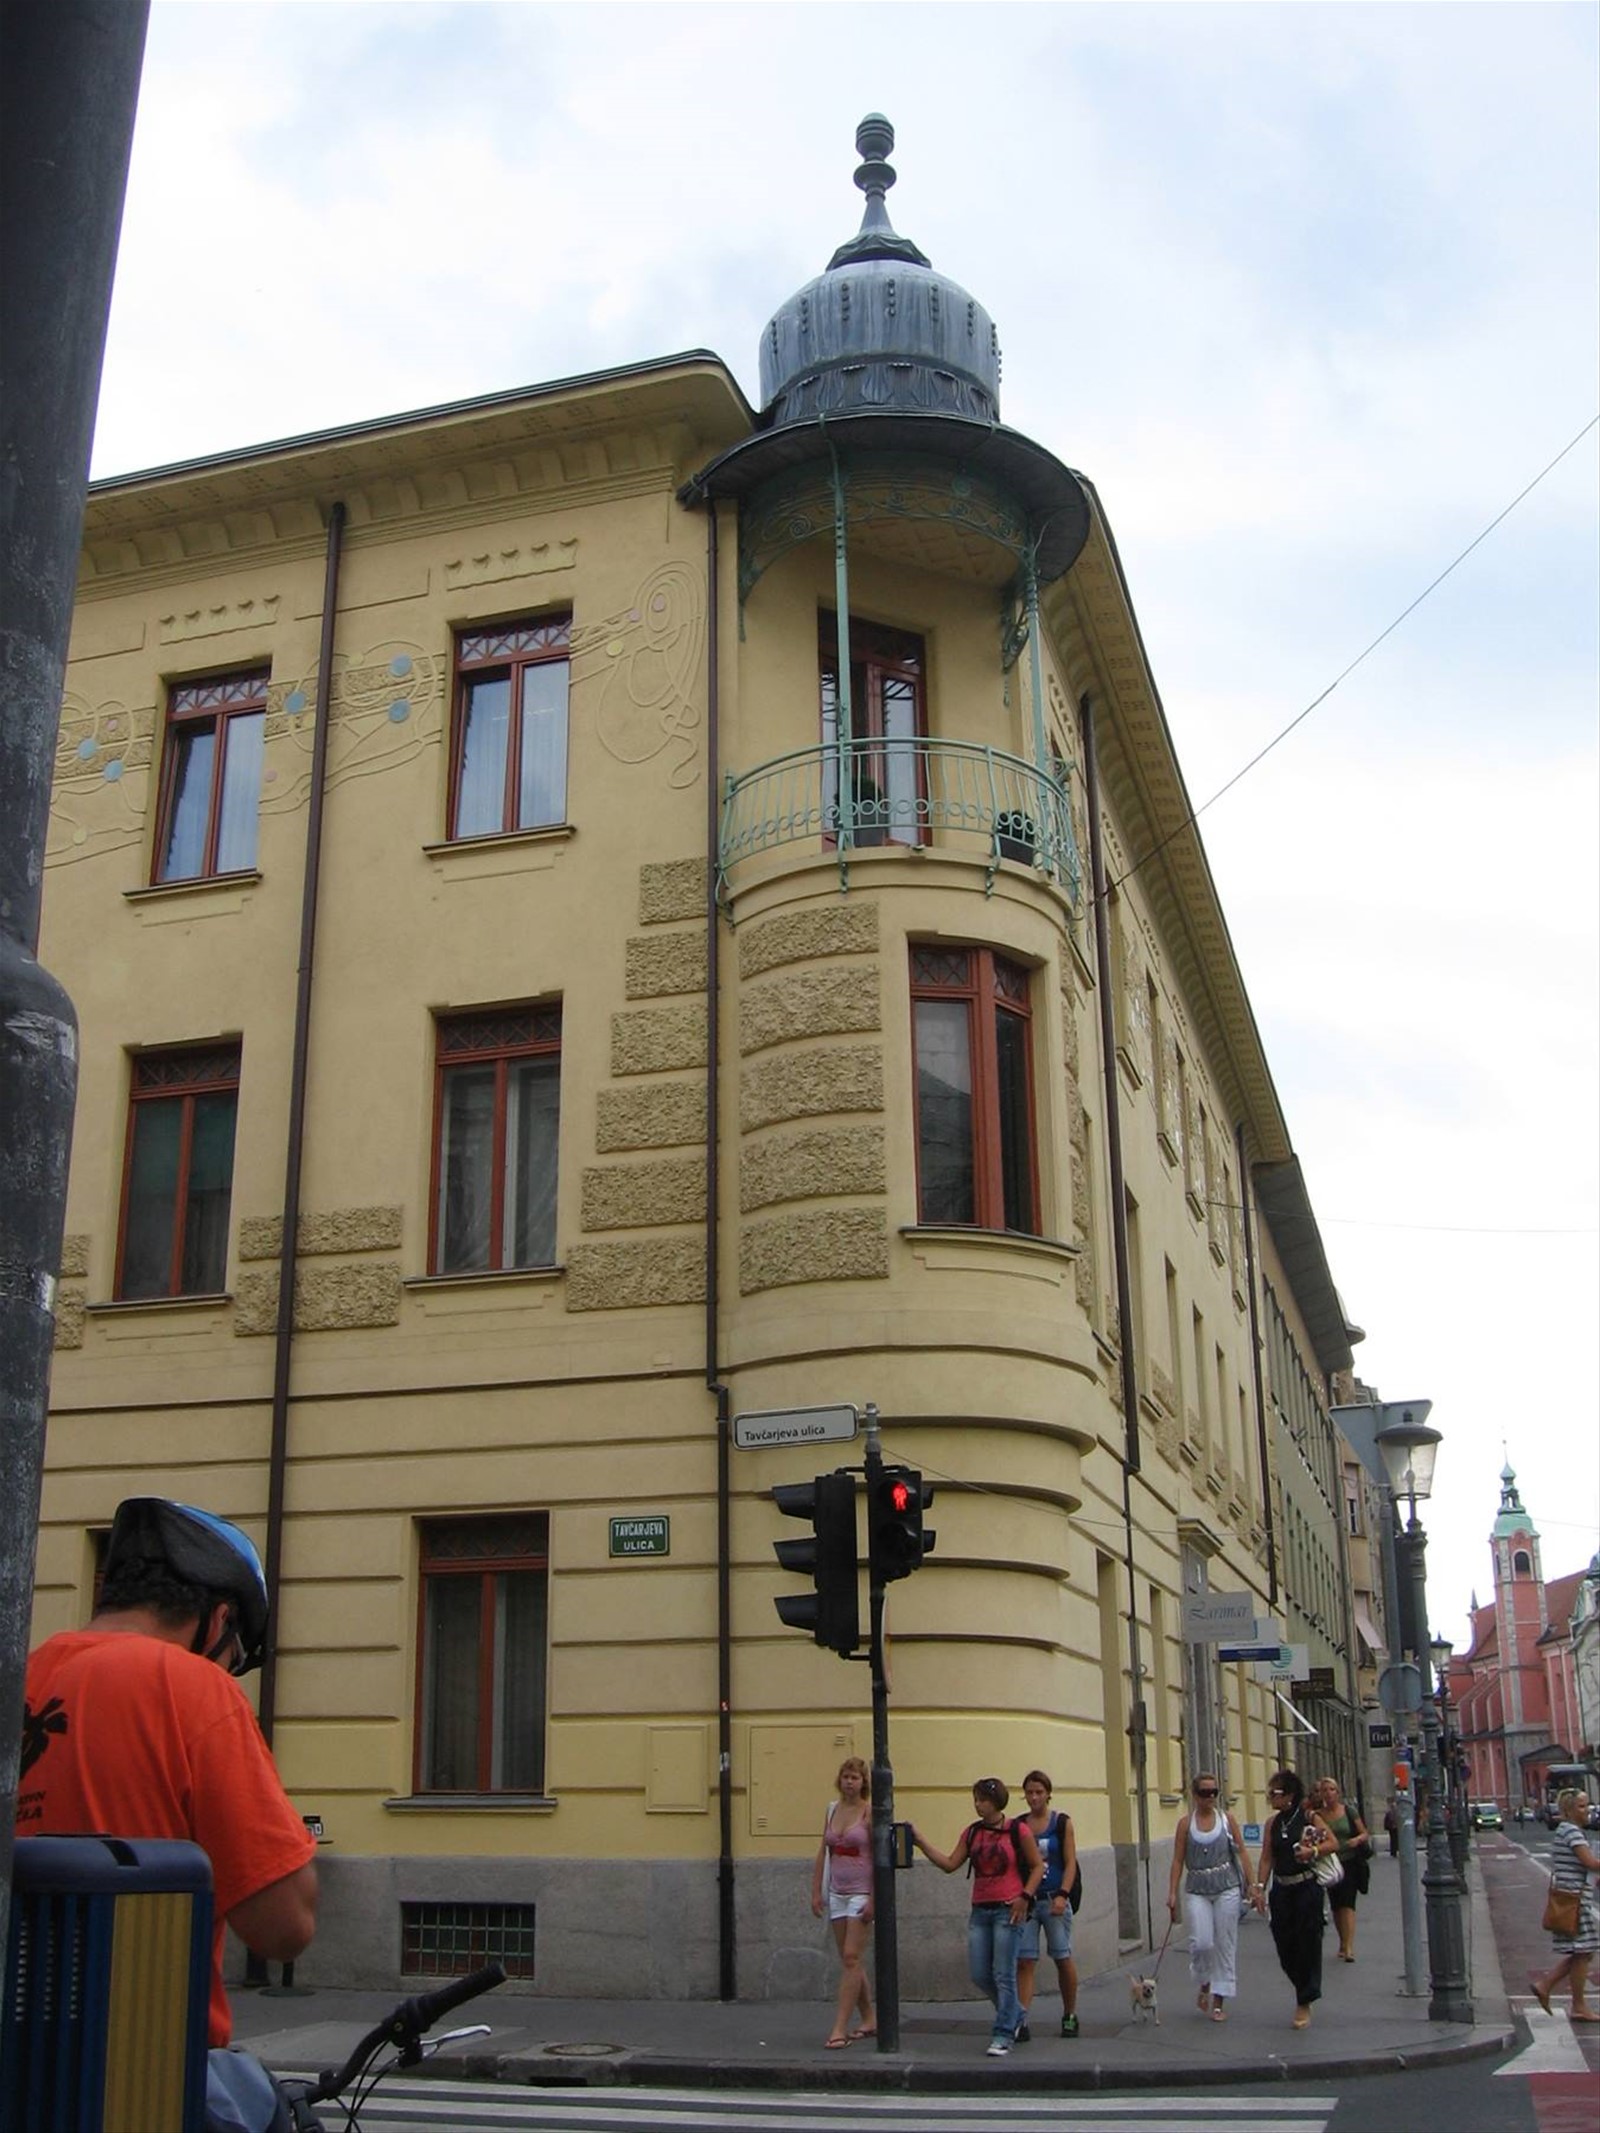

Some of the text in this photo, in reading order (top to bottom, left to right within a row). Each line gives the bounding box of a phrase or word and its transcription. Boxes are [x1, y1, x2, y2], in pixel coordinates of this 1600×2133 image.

[745, 1425, 826, 1441] Tavčarjeva ulica
[624, 1540, 655, 1550] ULICA
